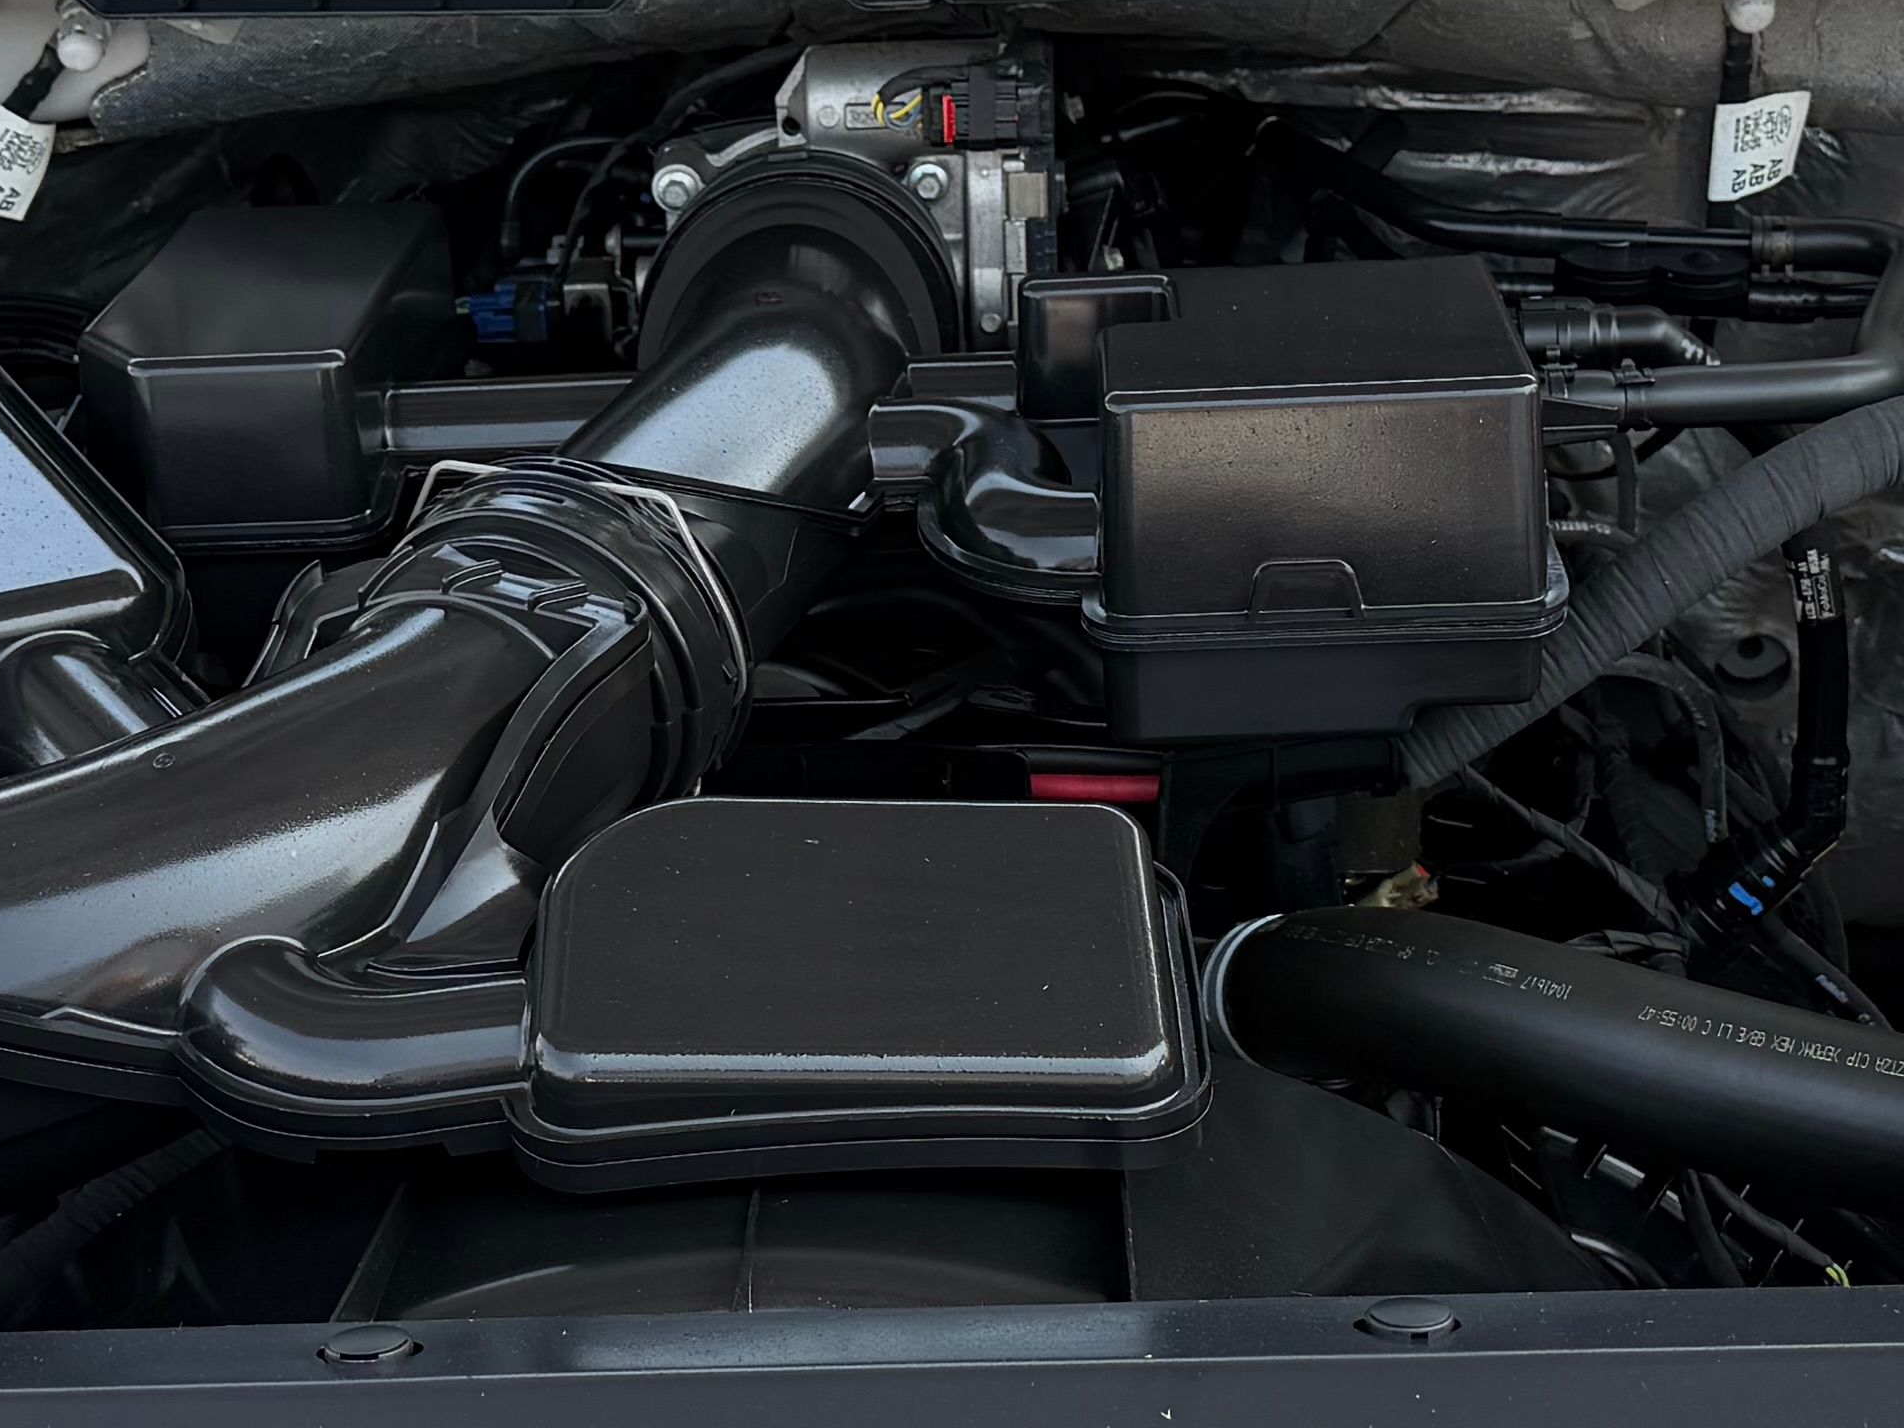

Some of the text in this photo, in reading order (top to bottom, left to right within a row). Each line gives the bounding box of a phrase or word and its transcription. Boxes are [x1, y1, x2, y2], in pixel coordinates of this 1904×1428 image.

[1730, 167, 1747, 195] AB
[1747, 162, 1767, 189] AB
[1766, 156, 1784, 182] AB
[1636, 1001, 1699, 1033] 00:55:47
[1700, 1017, 1713, 1036] C
